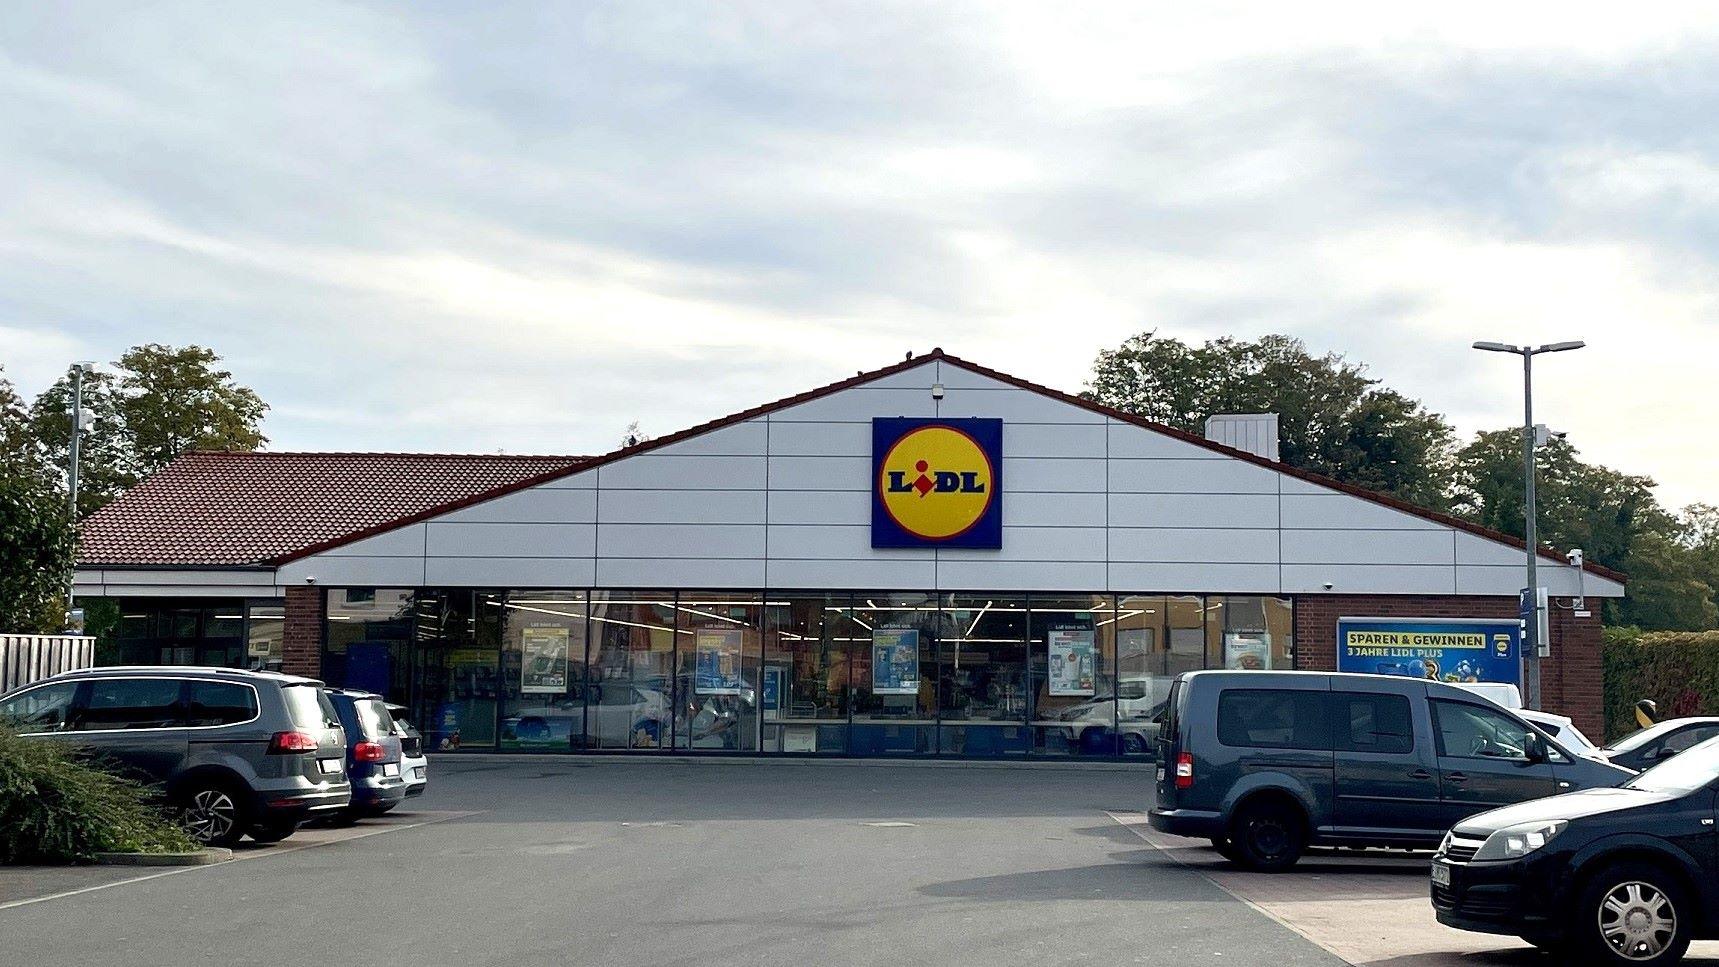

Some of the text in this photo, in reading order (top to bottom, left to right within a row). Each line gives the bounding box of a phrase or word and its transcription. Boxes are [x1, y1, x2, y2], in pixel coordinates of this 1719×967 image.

[888, 460, 985, 498] LIDL
[1350, 633, 1483, 646] SPAREN & GEWINNEN
[1347, 647, 1443, 658] 3 JAHRE LIDL PLUS
